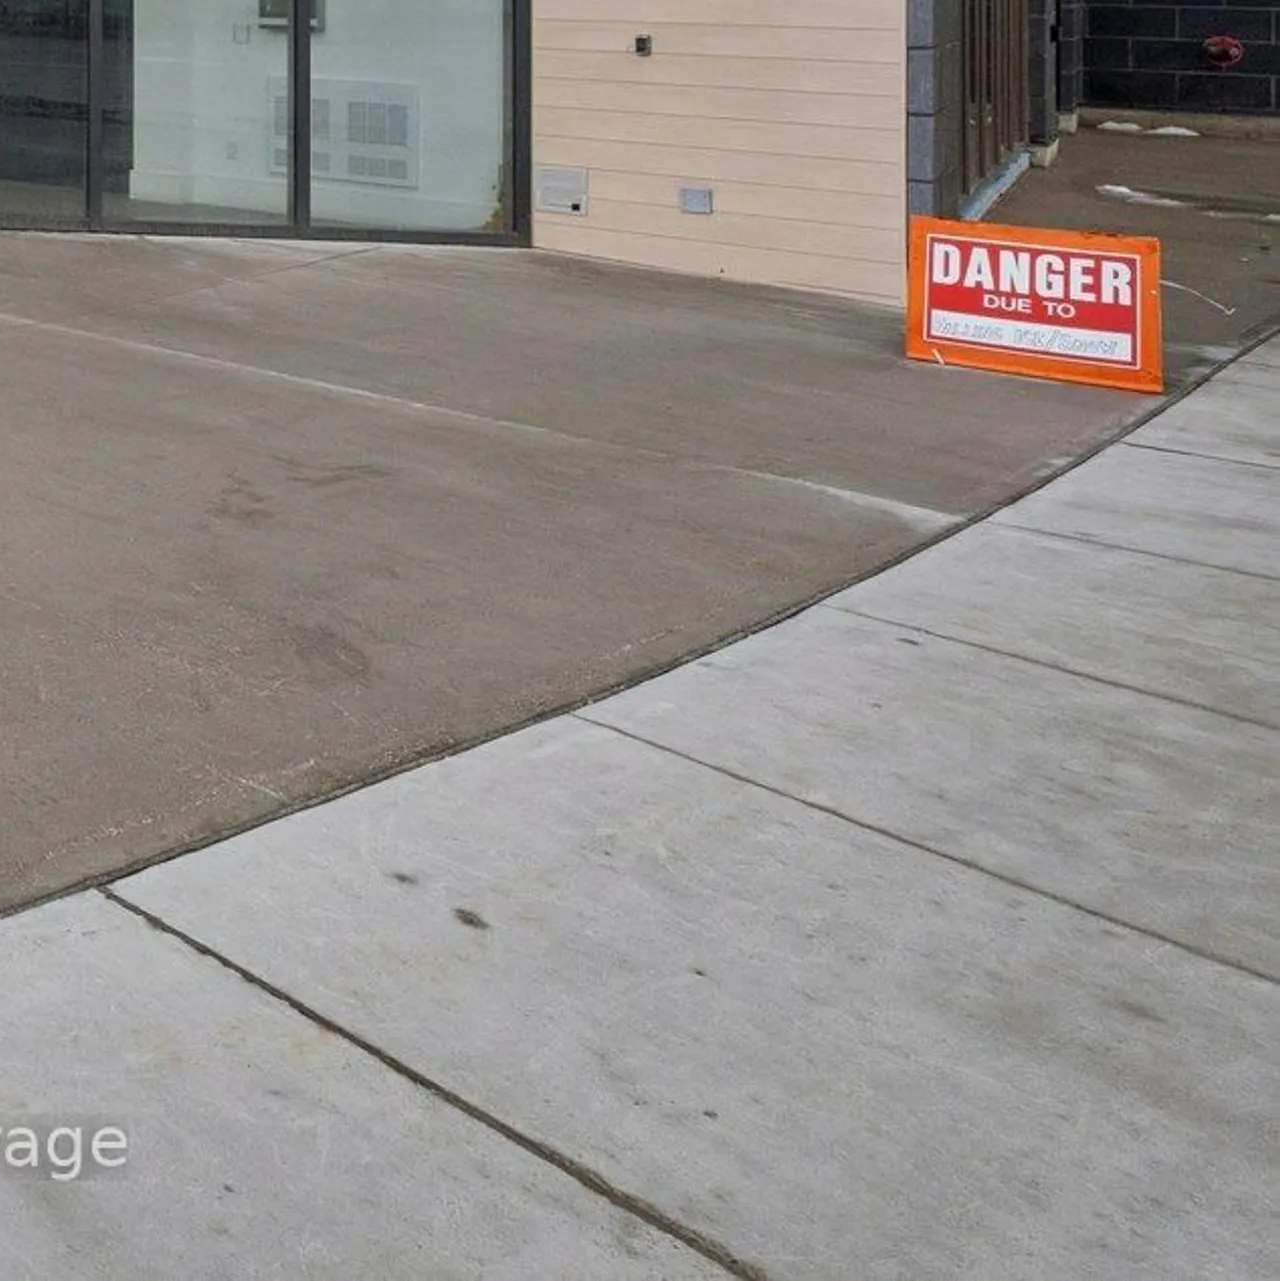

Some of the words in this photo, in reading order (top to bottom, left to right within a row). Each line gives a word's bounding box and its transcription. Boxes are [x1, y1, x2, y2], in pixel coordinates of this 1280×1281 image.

[931, 242, 1133, 306] DANGER
[982, 294, 1033, 316] DUE
[1042, 301, 1077, 319] TO
